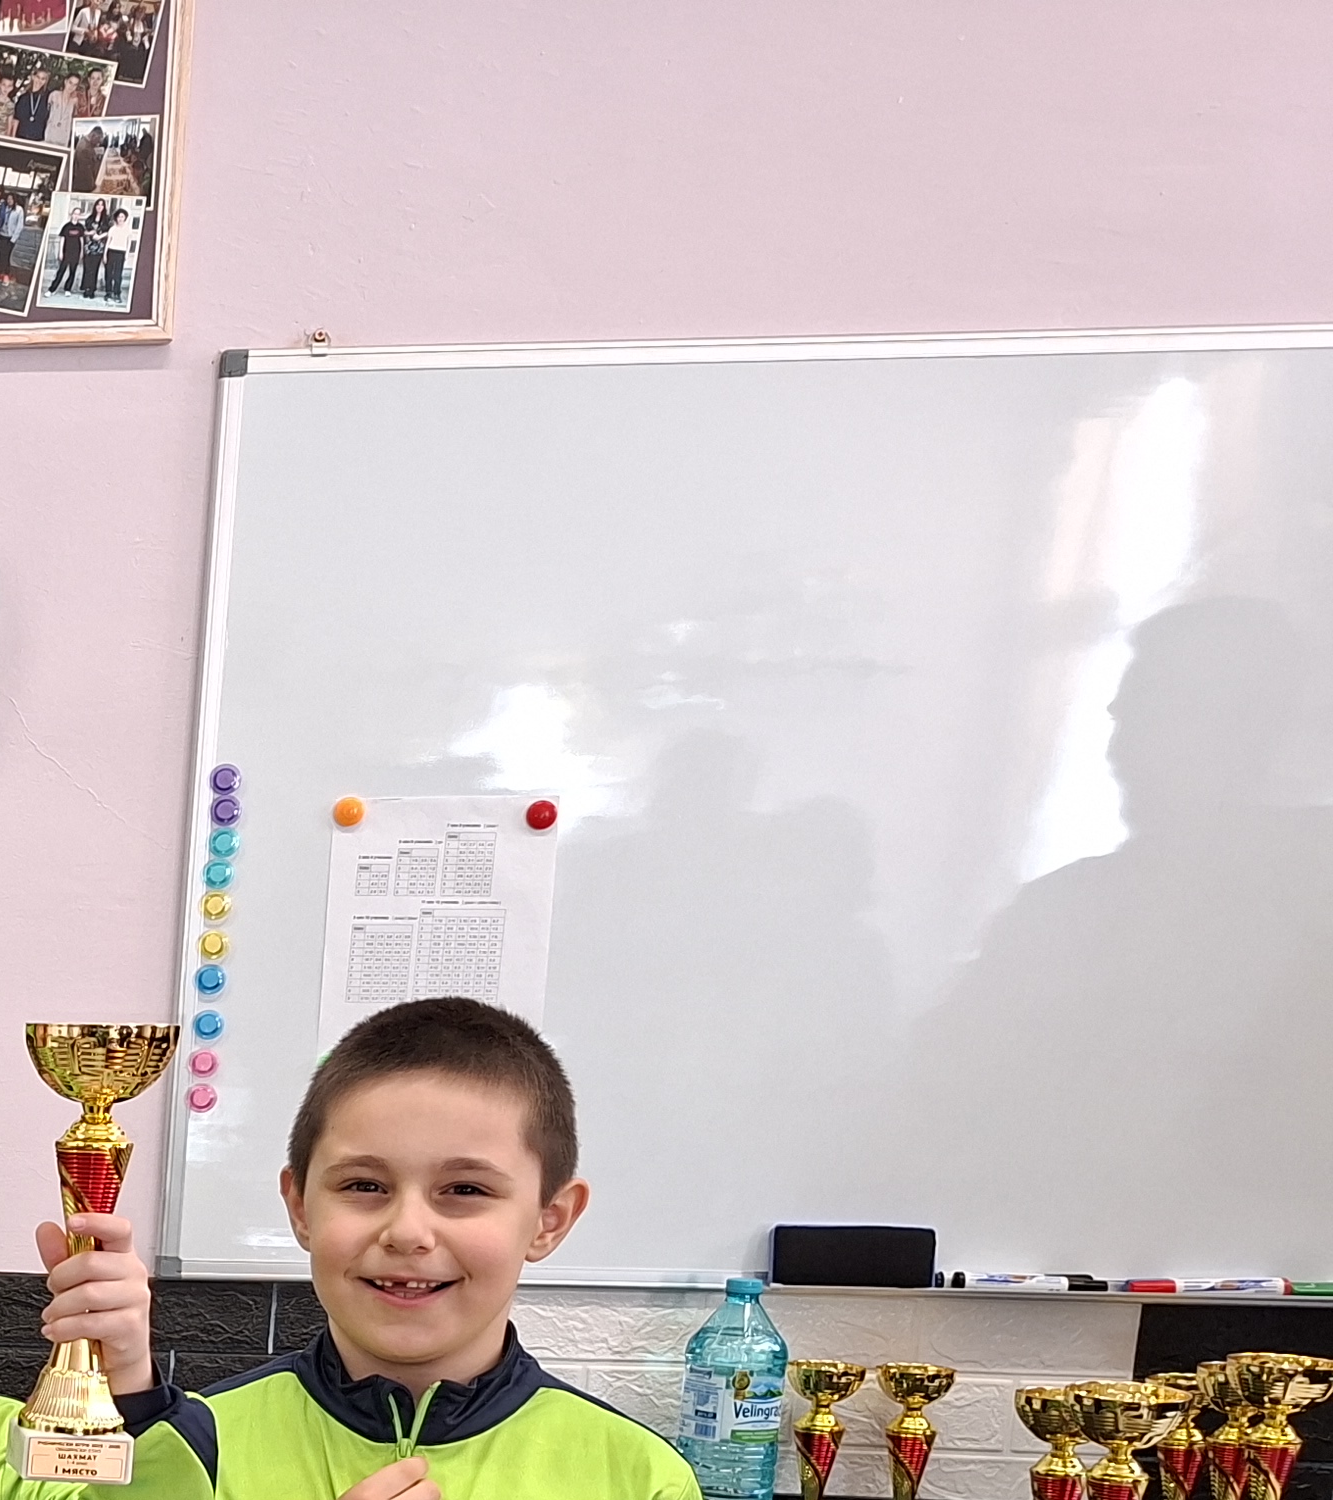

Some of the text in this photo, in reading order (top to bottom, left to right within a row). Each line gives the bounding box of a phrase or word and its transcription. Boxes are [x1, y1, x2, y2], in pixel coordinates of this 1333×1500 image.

[734, 1401, 782, 1420] Velingra
[58, 1453, 98, 1462] ШАХМАТ
[62, 1467, 98, 1476] МЯСТО
